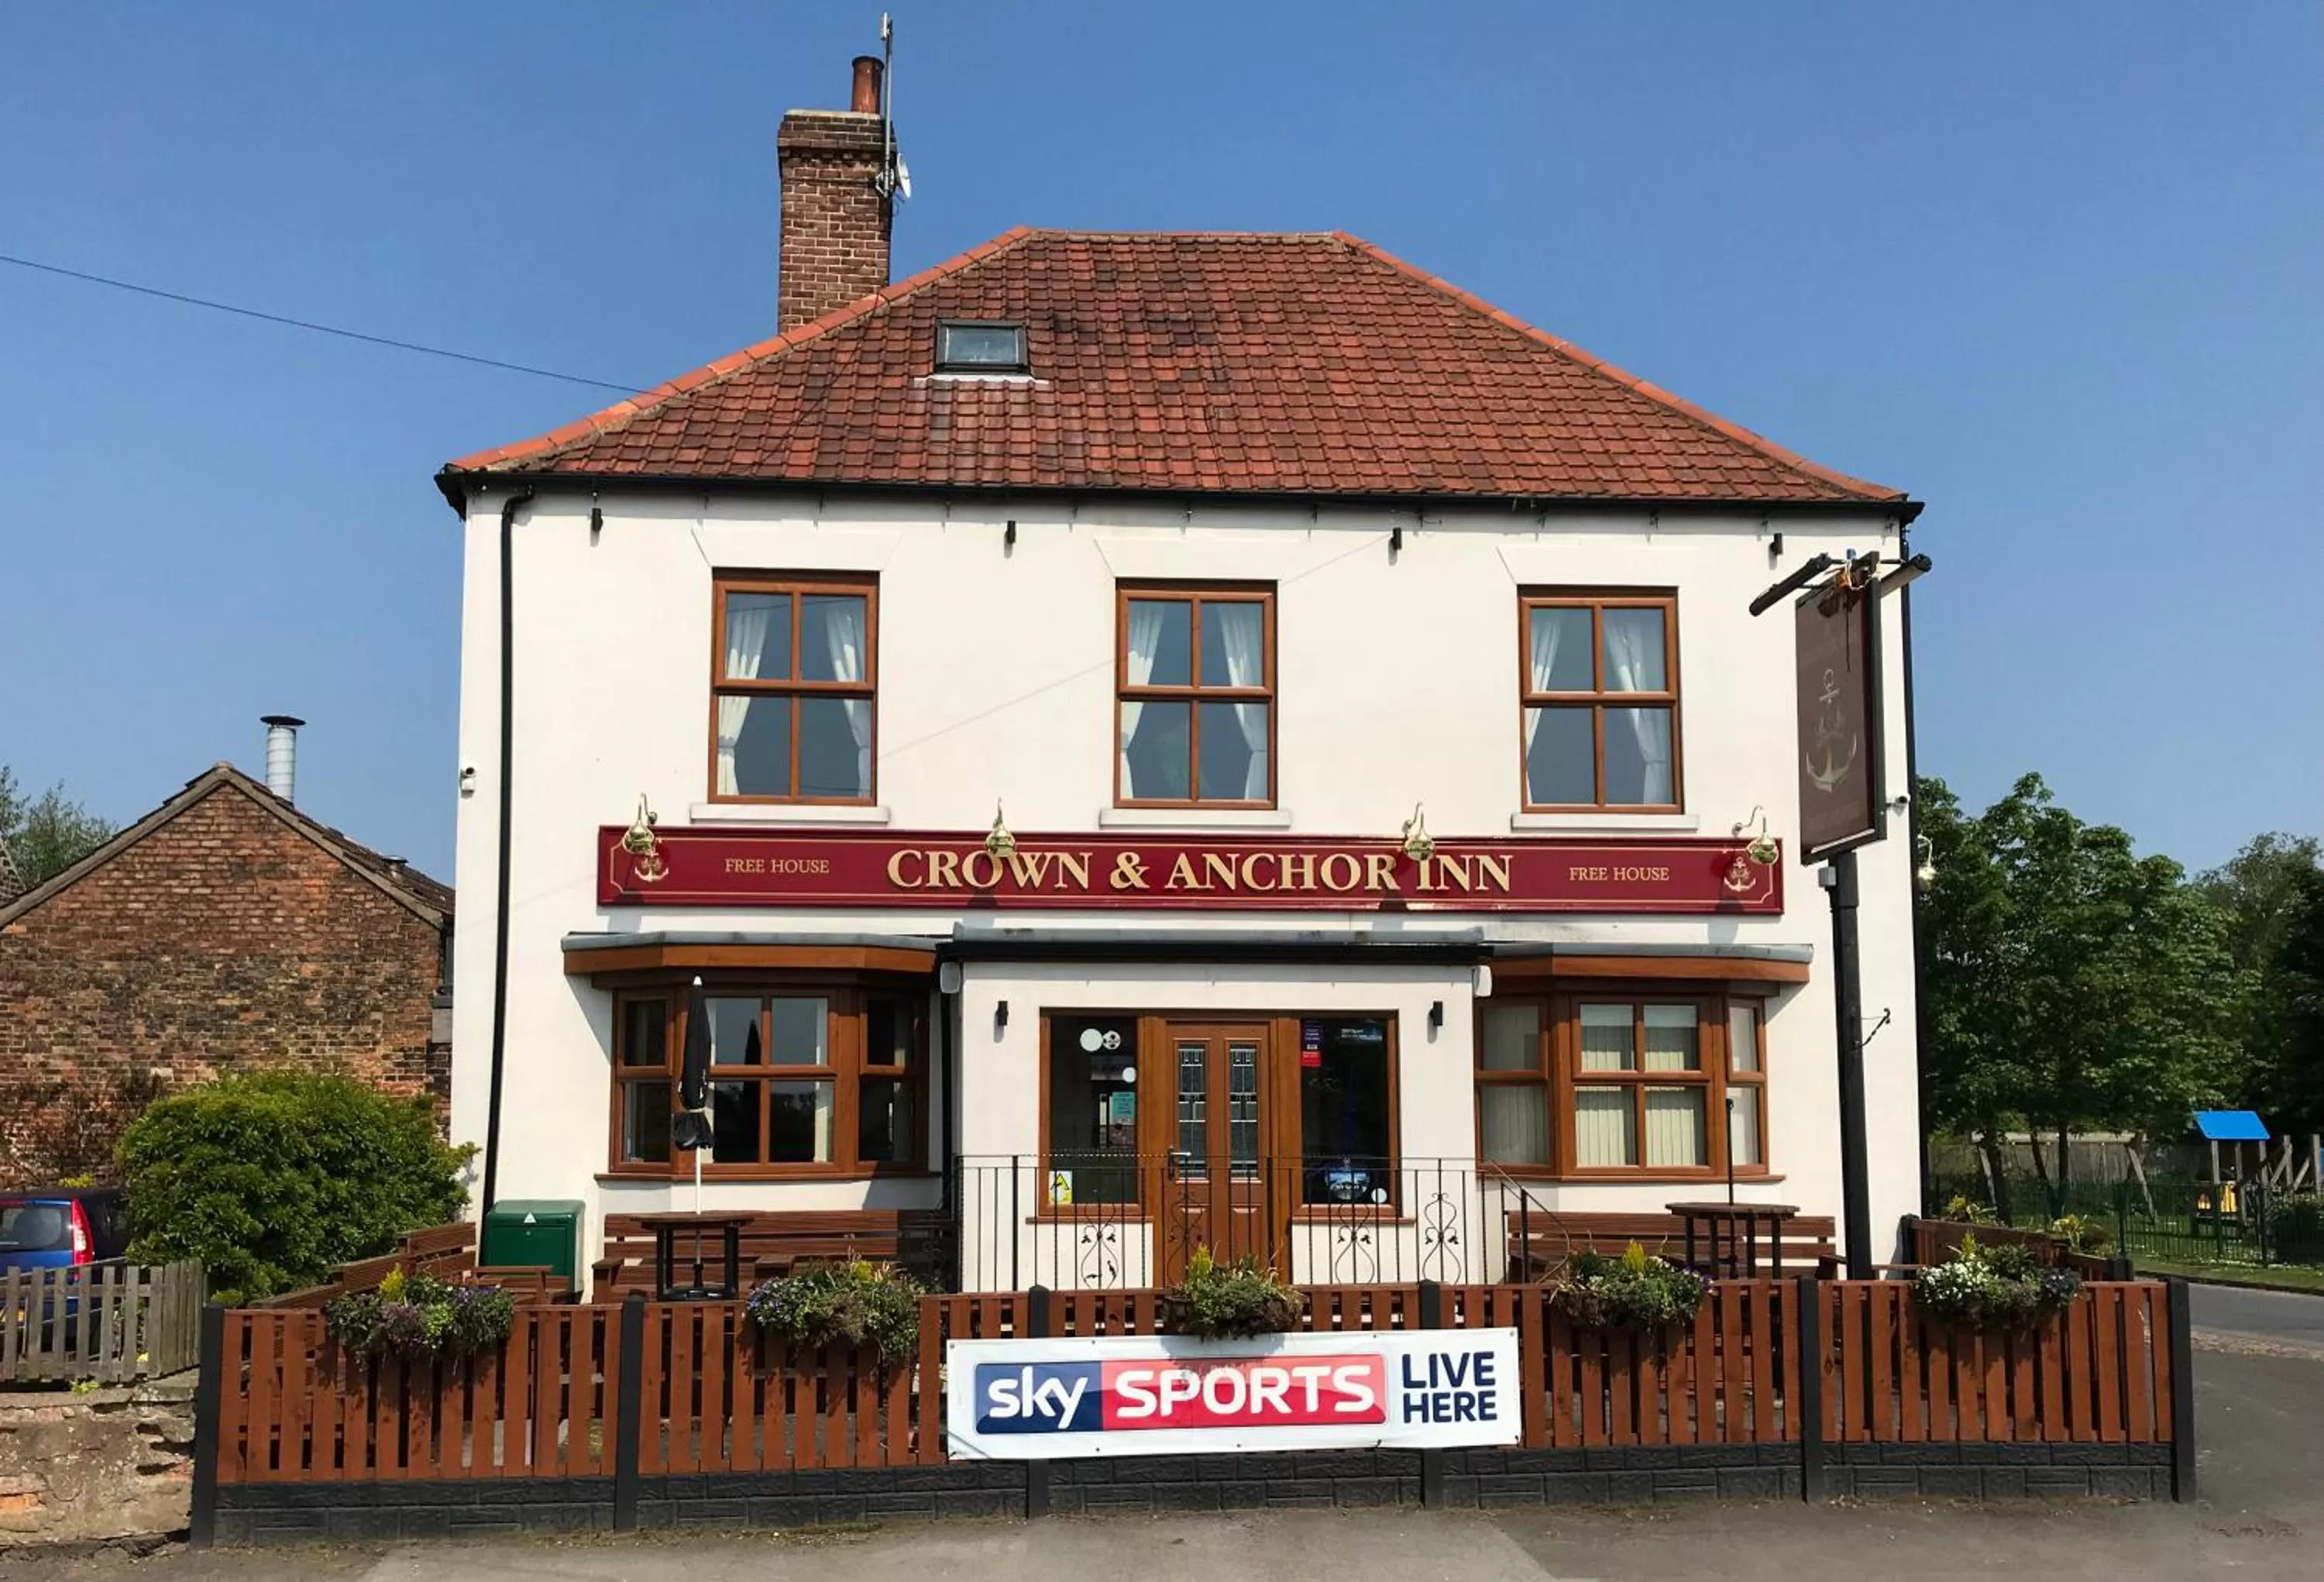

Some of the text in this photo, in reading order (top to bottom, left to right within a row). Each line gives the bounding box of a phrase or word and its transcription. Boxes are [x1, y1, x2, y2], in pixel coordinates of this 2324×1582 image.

[725, 858, 830, 873] FREE HOUSE
[887, 849, 1514, 892] CROWN & ANCHOR INN
[1569, 866, 1669, 882] FREE HOUSE
[1401, 1351, 1496, 1389] LIVE
[987, 1364, 1375, 1429] sky SPORTS
[1403, 1390, 1498, 1424] HERE
